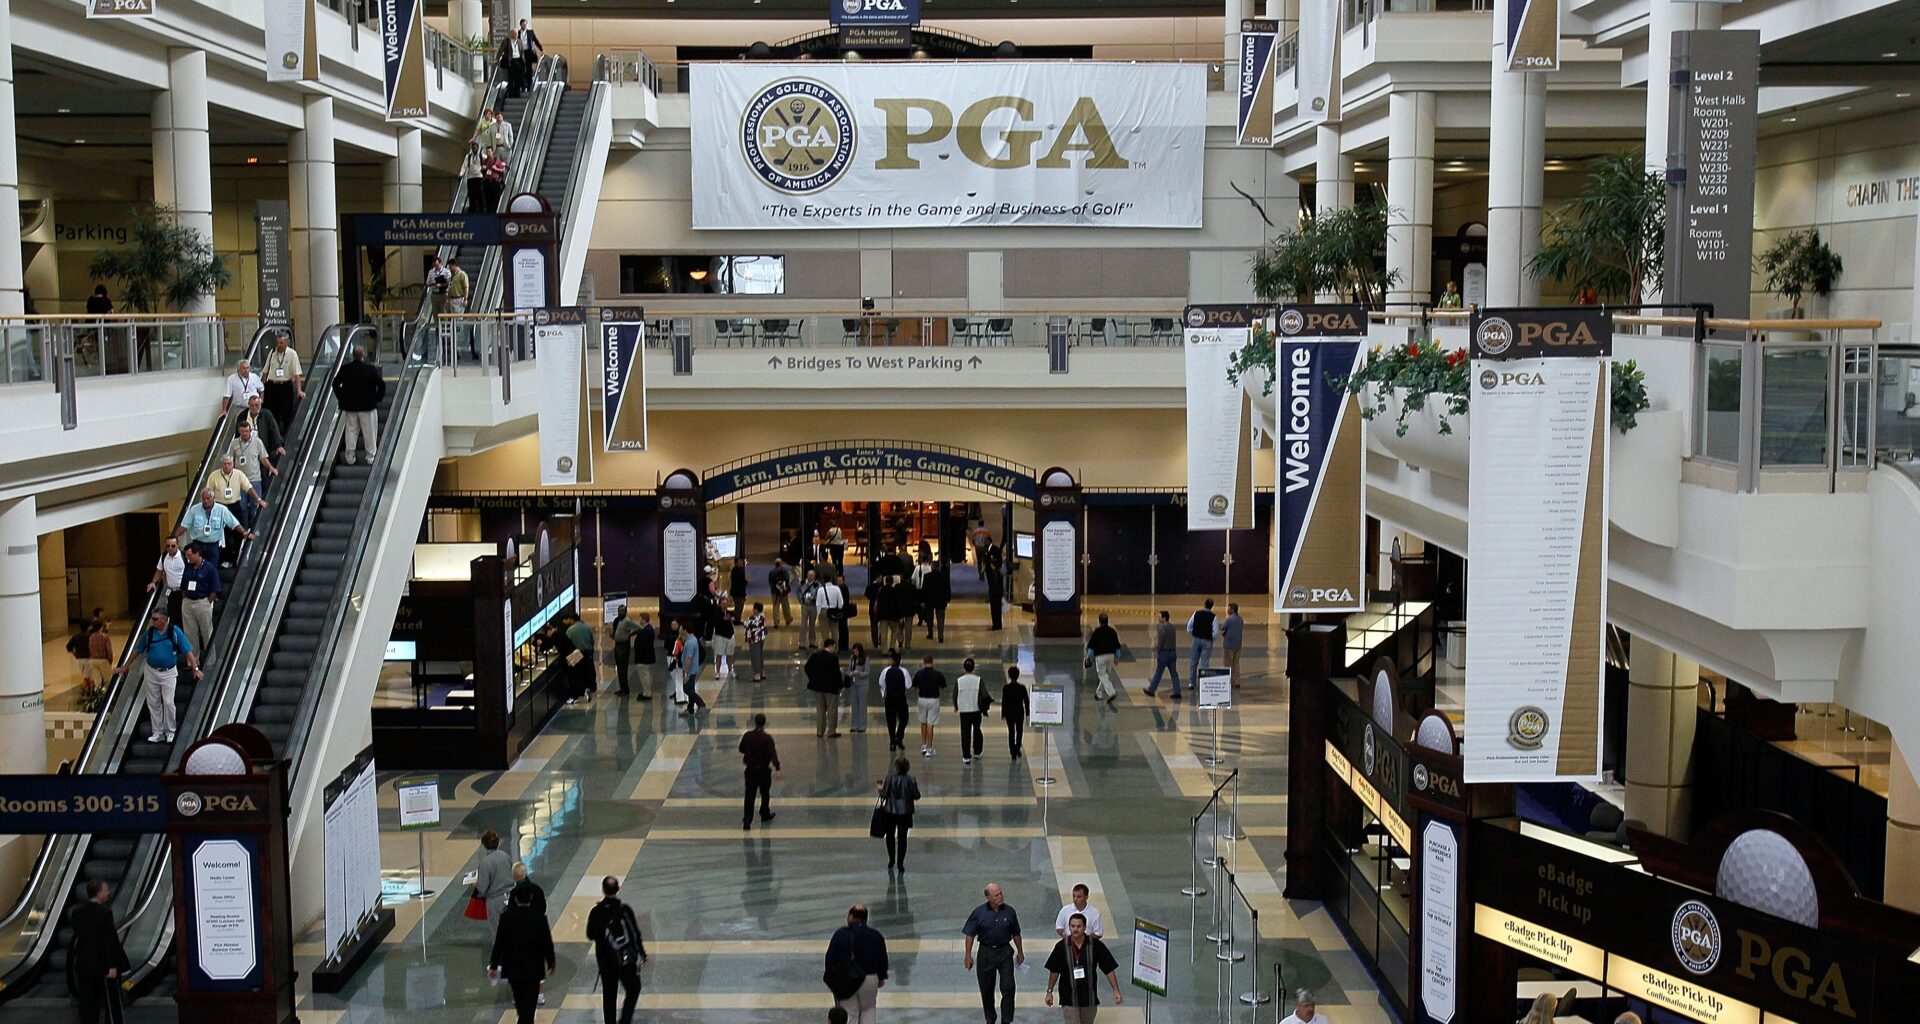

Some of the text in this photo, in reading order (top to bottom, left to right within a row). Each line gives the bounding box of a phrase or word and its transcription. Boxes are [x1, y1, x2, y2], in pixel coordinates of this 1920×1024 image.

[864, 0, 903, 11] PGA
[849, 28, 898, 36] PGA Member
[845, 37, 878, 45] Business
[880, 37, 904, 45] Center
[1526, 56, 1552, 66] PGA
[1242, 36, 1255, 98] Welcome
[1694, 70, 1734, 81] Level 2
[1694, 94, 1746, 105] West Halls
[403, 107, 424, 116] PGA
[1693, 107, 1727, 117] Rooms
[746, 92, 774, 171] PROFESSIONAL
[762, 125, 837, 148] PGA
[828, 98, 850, 171] ASSOCIATION
[874, 96, 1130, 170] PGA
[1701, 130, 1729, 139] W209
[1251, 136, 1269, 144] PGA
[1700, 152, 1728, 161] W225
[788, 162, 810, 172] 1916
[768, 171, 832, 189] OF AMERICA
[1699, 175, 1728, 184] W232
[1698, 186, 1728, 195] W240
[1846, 181, 1890, 208] CHAPIN
[803, 204, 862, 219] Experts
[867, 203, 881, 217] in
[887, 203, 912, 216] the
[917, 203, 962, 216] Game
[967, 203, 996, 216] and
[999, 202, 1067, 216] Business
[1072, 202, 1088, 216] of
[1690, 204, 1728, 214] Level 1
[393, 219, 465, 229] PGA Member
[520, 223, 548, 233] PGA
[54, 224, 128, 244] Parking
[384, 230, 475, 241] Business Center
[1689, 229, 1723, 238] Rooms
[1696, 251, 1726, 260] W110
[265, 309, 286, 317] West
[551, 312, 581, 322] PGA
[615, 311, 640, 319] PGA
[1207, 311, 1245, 323] PGA
[1306, 313, 1358, 330] PGA
[1201, 335, 1222, 343] PGA
[1483, 321, 1598, 347] PGA PGA
[606, 326, 620, 397] Welcome
[787, 356, 963, 371] Bridges To West Parking
[1501, 372, 1546, 386] PGA
[1285, 346, 1311, 494] Welcome
[620, 440, 642, 448] PGA
[733, 453, 1016, 490] Earn, Learn & Grow The Game of Golf
[473, 497, 532, 508] Products
[672, 498, 696, 506] PGA
[1052, 494, 1076, 504] PGA
[1311, 588, 1354, 602] PGA
[1429, 771, 1460, 797] PGA
[0, 795, 160, 813] Rooms 300-315
[203, 795, 257, 811] PGA
[202, 861, 241, 869] Welcome!
[1538, 863, 1593, 895] eBadge
[1538, 887, 1592, 925] Pick up
[1503, 919, 1573, 955] eBadge Pick-Up
[1680, 926, 1712, 949] PGA
[1507, 934, 1568, 963] Confirmation Required
[1736, 928, 1857, 1019] PGA
[1642, 971, 1723, 1012] eBadge Pick-Up
[1646, 987, 1717, 1022] Confirmation Required
